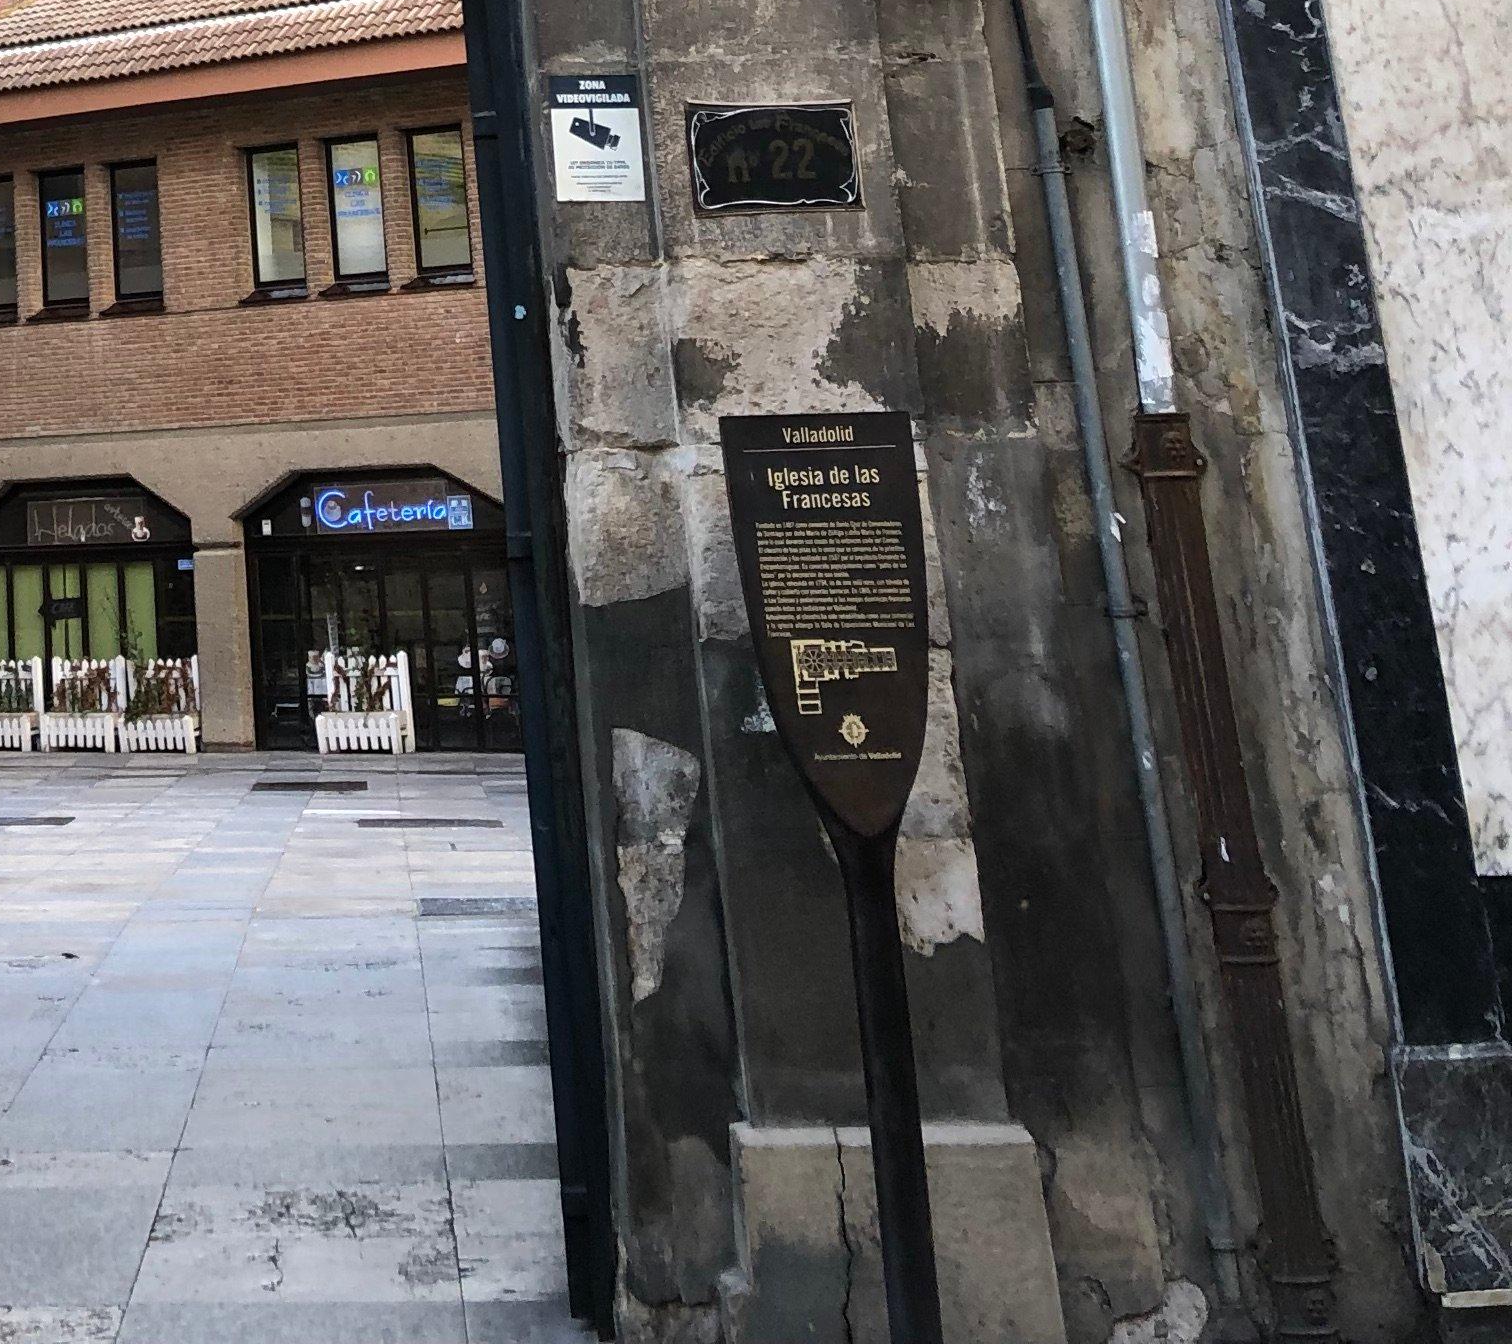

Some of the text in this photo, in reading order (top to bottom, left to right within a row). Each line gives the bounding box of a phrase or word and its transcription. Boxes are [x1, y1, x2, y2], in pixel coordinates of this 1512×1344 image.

[578, 80, 606, 90] ZONA
[556, 93, 631, 104] VIDEOVIGILADA
[768, 138, 818, 181] 22
[782, 425, 854, 444] Valladolid
[767, 464, 880, 490] Iglesia de las
[317, 487, 447, 531] Cafetería
[782, 490, 871, 510] Francesas
[33, 504, 116, 544] Helados
